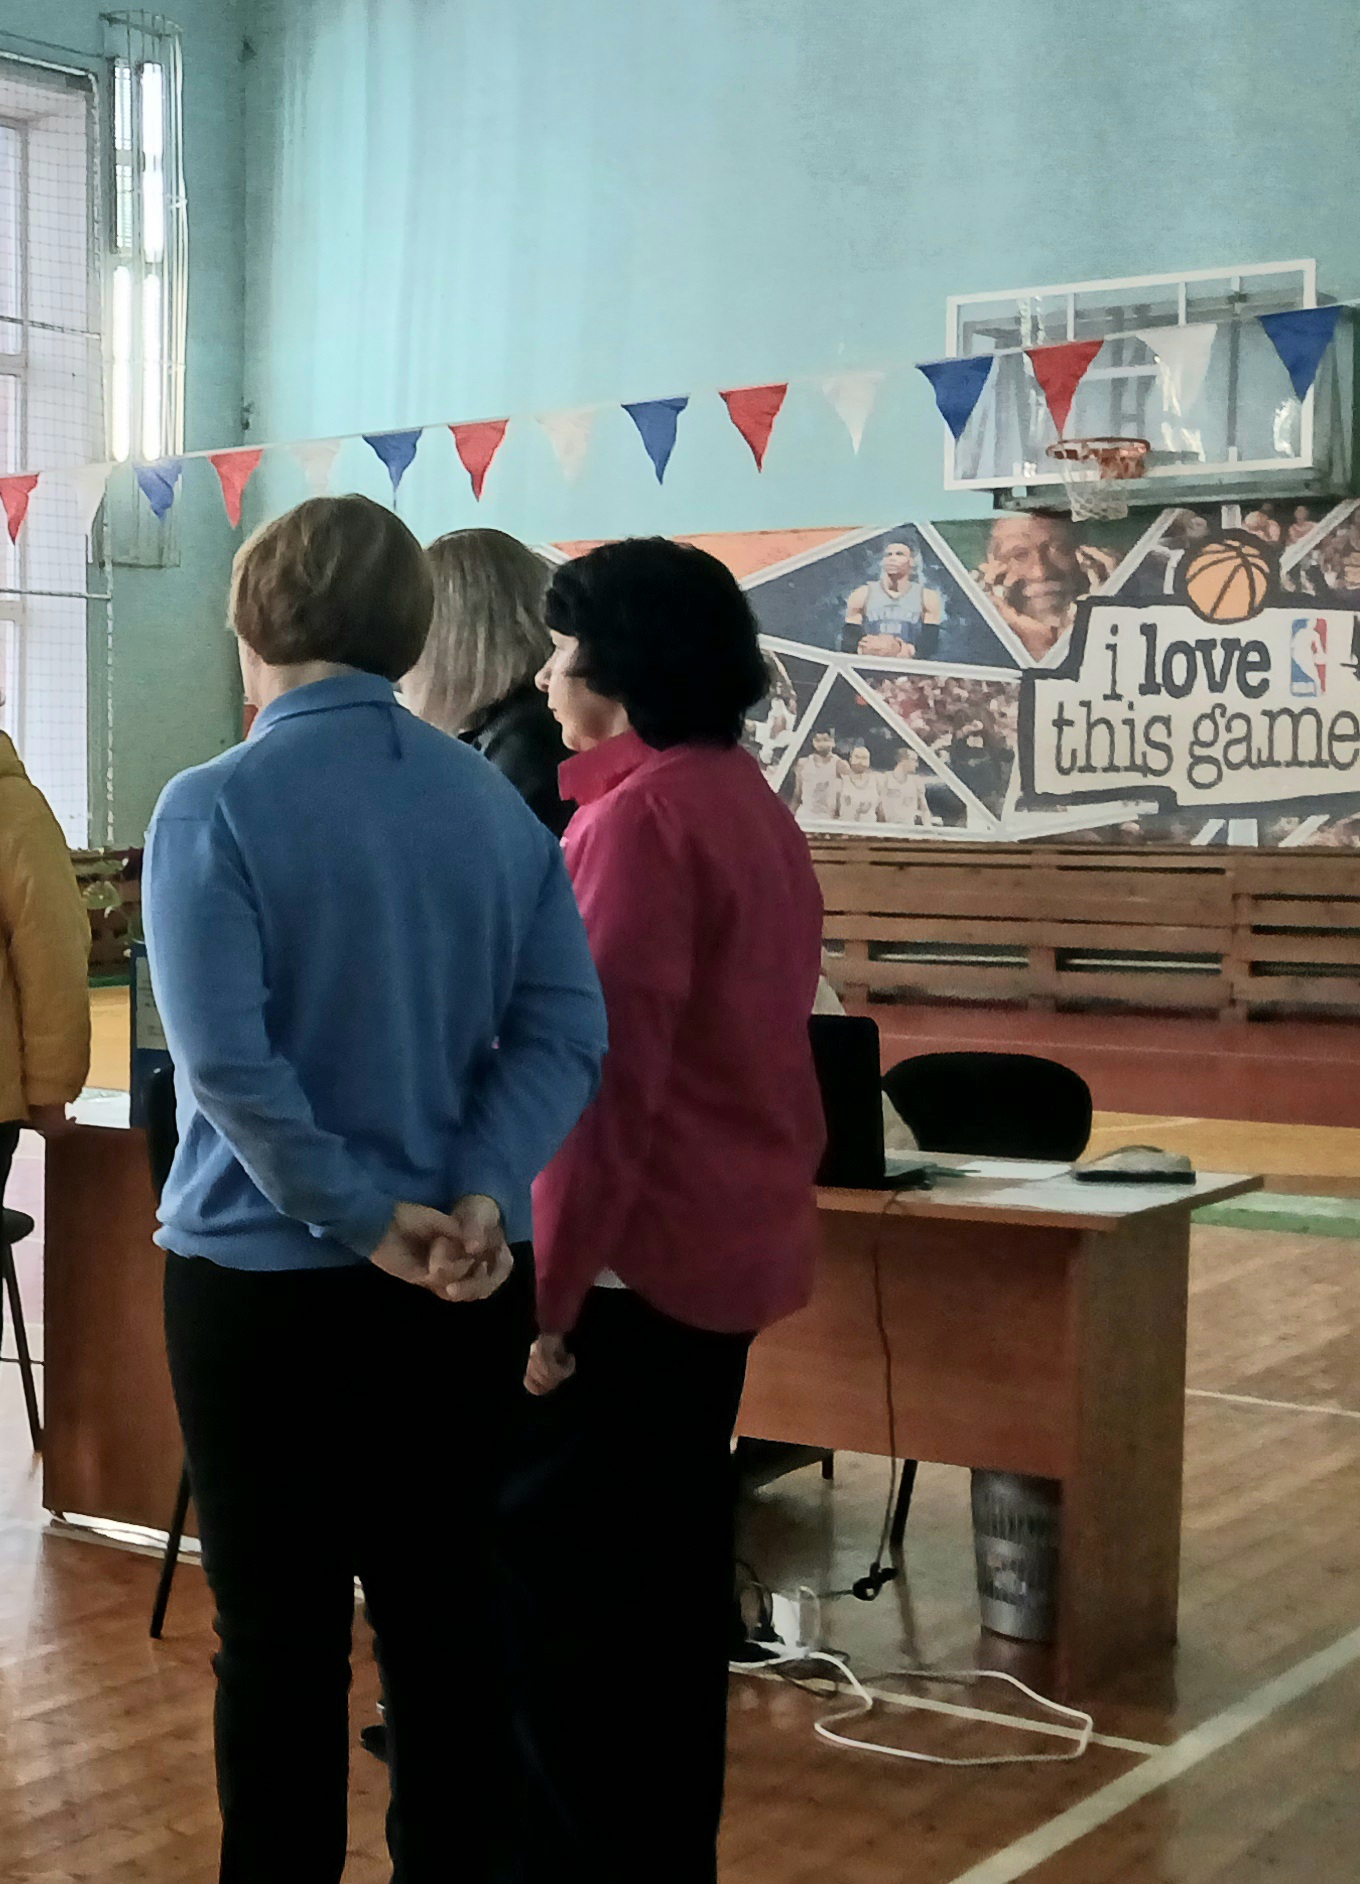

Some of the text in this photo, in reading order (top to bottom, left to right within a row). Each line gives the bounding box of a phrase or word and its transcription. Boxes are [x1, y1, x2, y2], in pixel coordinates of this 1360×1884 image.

[1102, 622, 1272, 701] i love
[1051, 700, 1360, 790] this game
